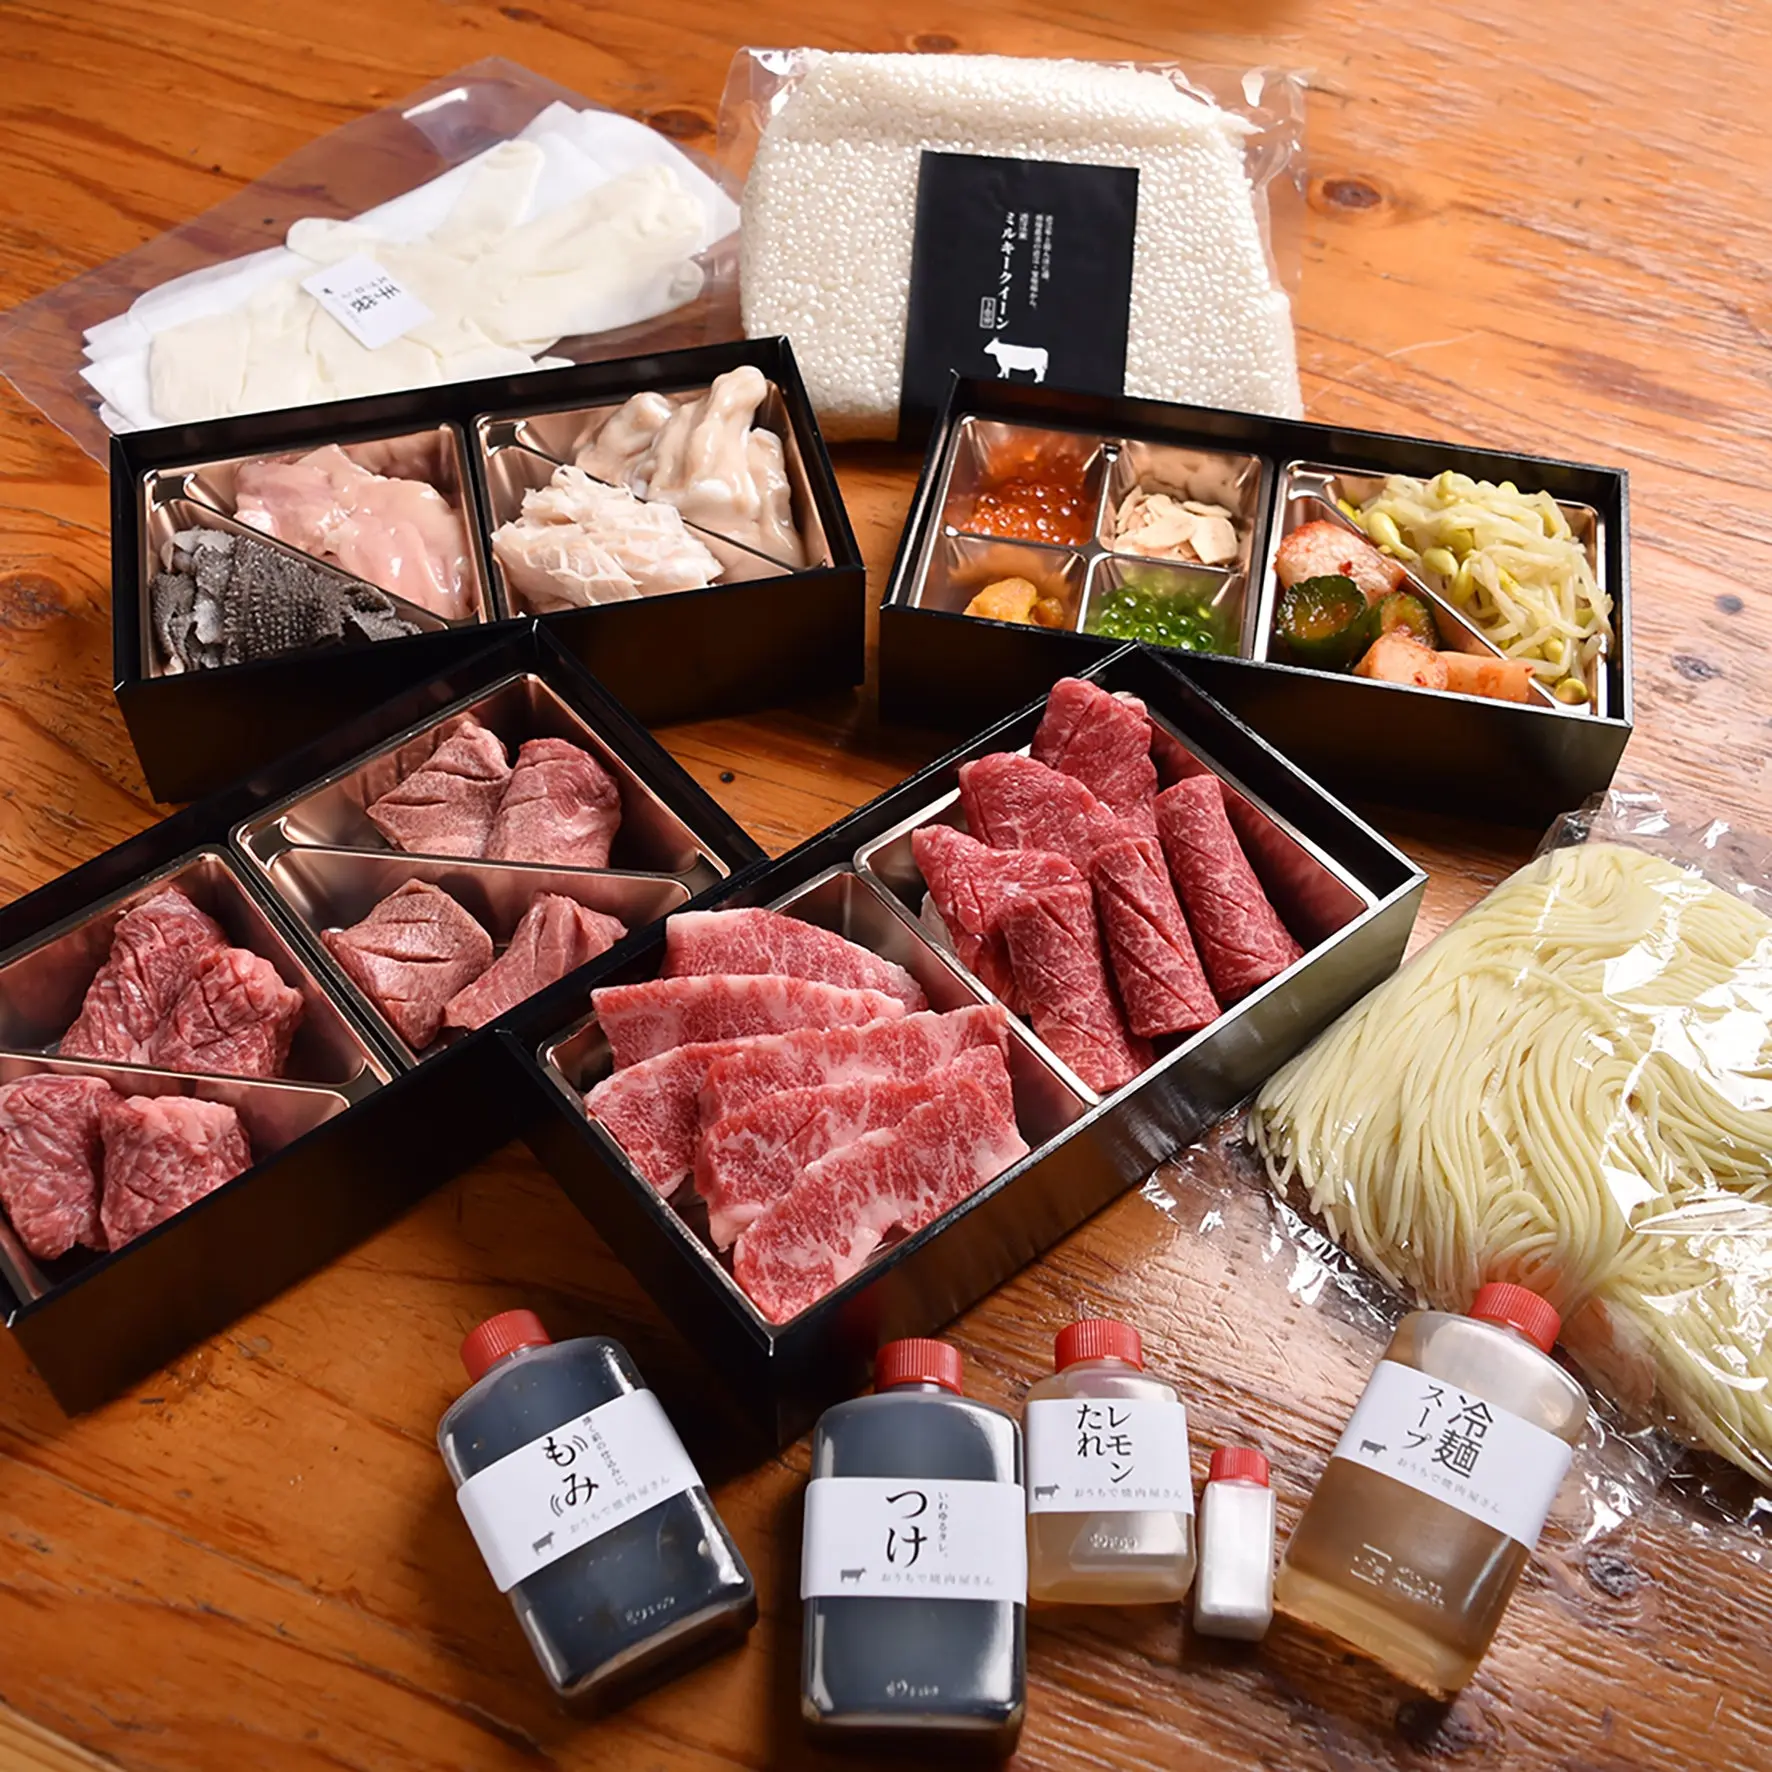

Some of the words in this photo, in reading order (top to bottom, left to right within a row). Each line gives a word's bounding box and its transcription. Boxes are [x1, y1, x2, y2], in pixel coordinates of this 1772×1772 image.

[996, 211, 1017, 330] ミルキークイーン
[1077, 1403, 1106, 1458] たれ
[1106, 1405, 1135, 1484] レモン
[1401, 1384, 1445, 1449] スープ
[1431, 1394, 1494, 1480] 冷麺
[542, 1436, 599, 1507] もみ
[1074, 1487, 1184, 1499] おうちで焼肉屋さん
[885, 1490, 928, 1569] つけ
